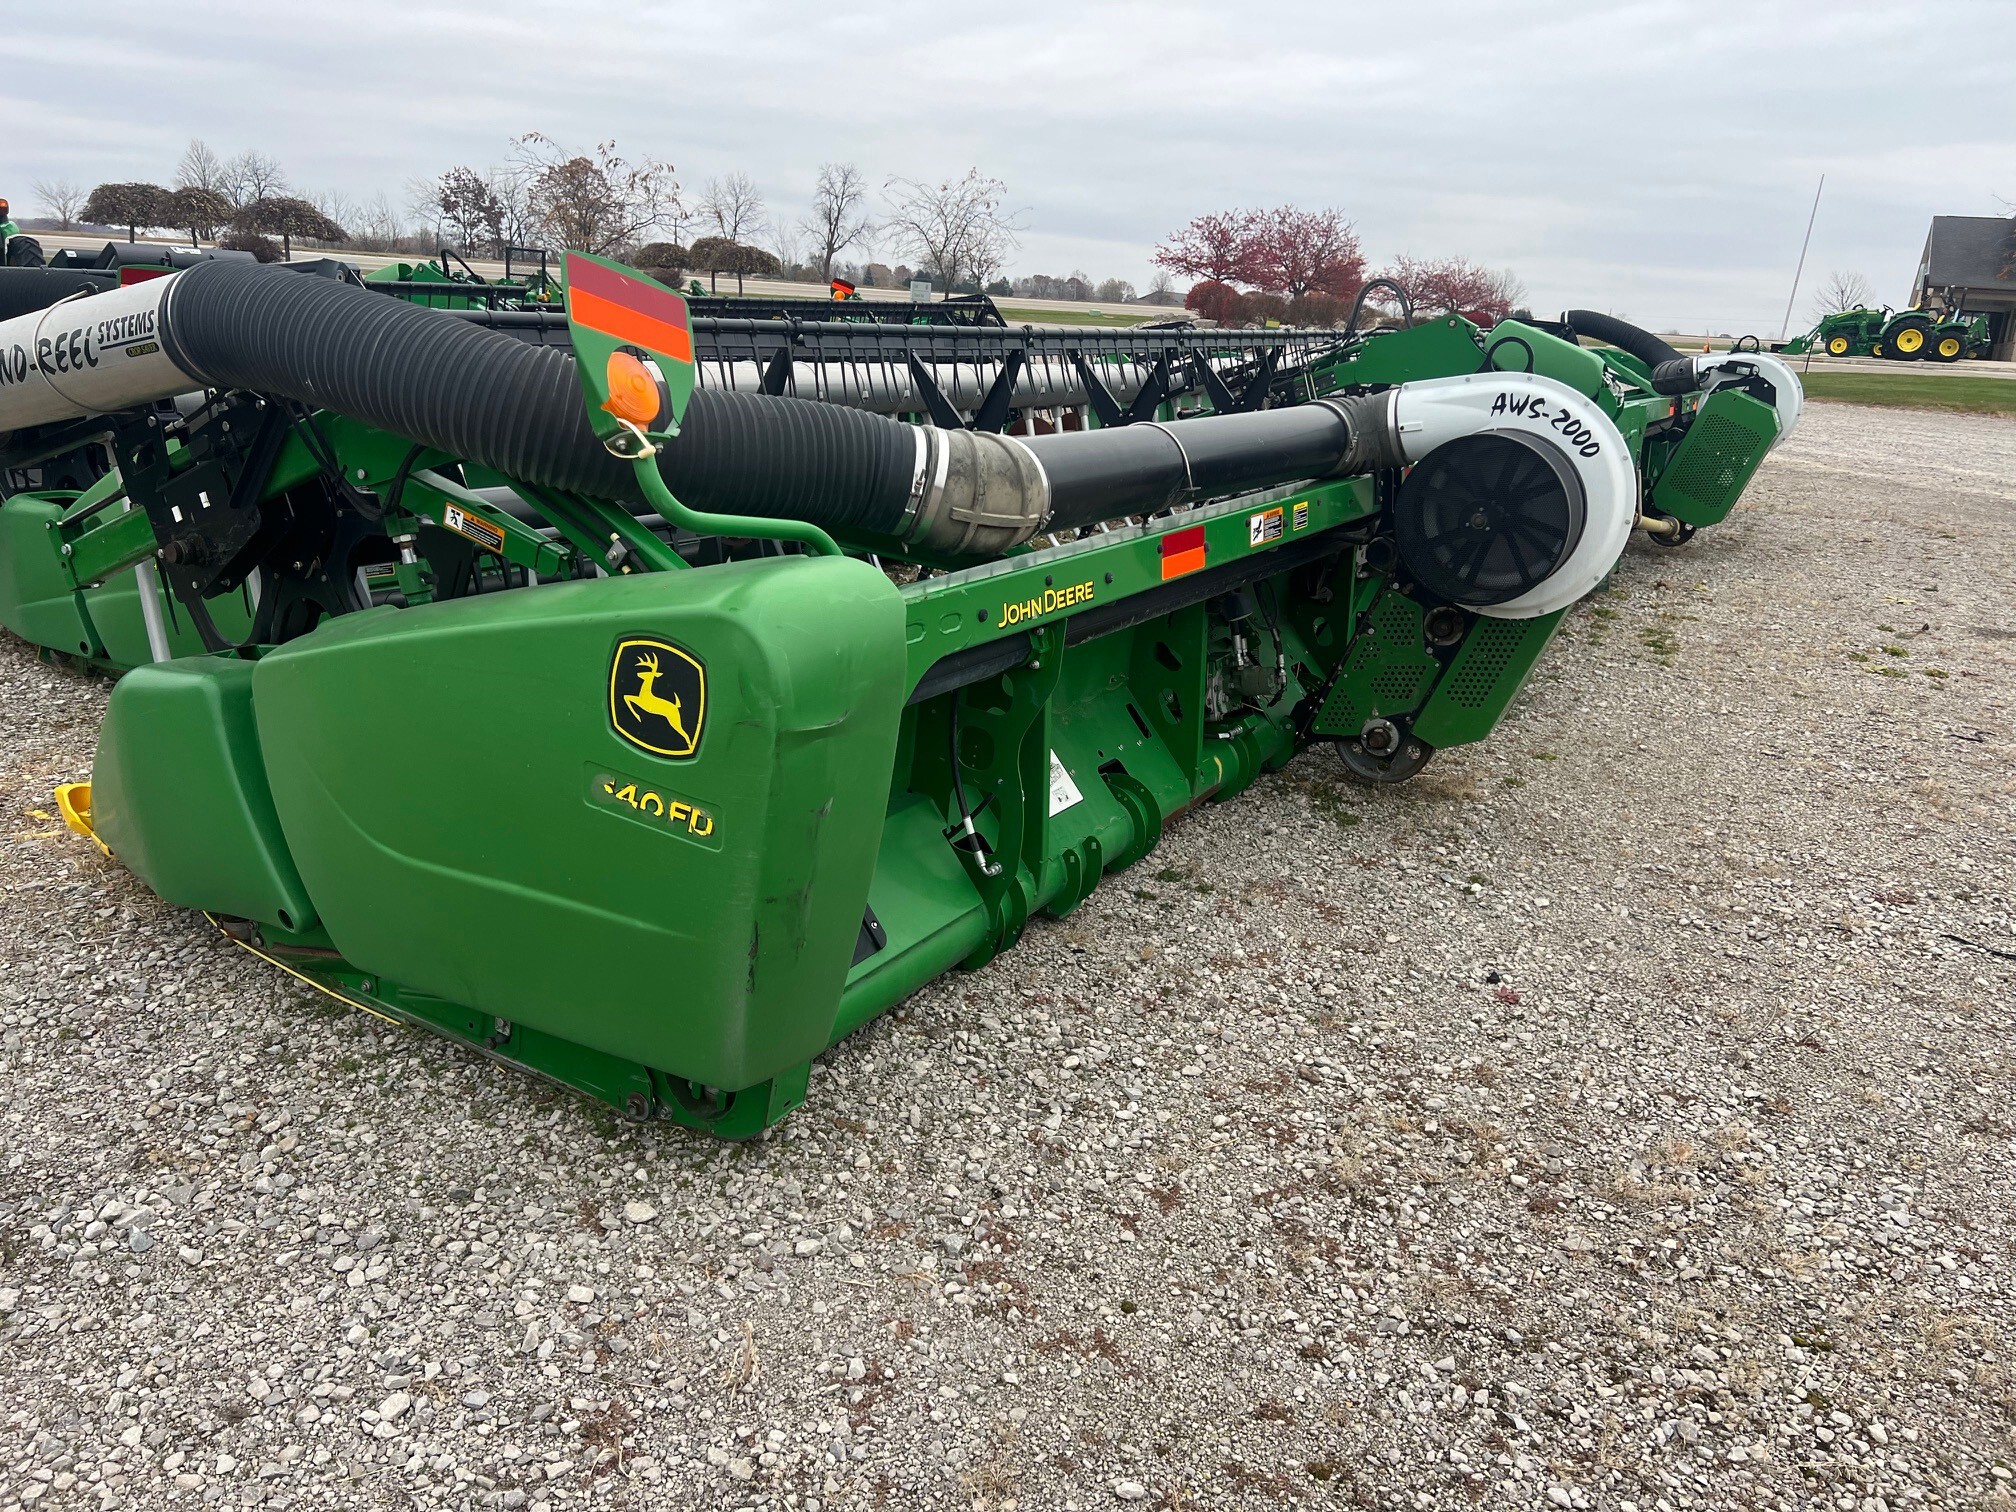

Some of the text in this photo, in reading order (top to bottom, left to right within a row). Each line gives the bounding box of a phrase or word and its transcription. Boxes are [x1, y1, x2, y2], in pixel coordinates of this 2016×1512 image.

[97, 309, 155, 344] SYSTEMS
[1491, 392, 1600, 458] AWS-2000
[998, 581, 1094, 628] JOHN DEERE
